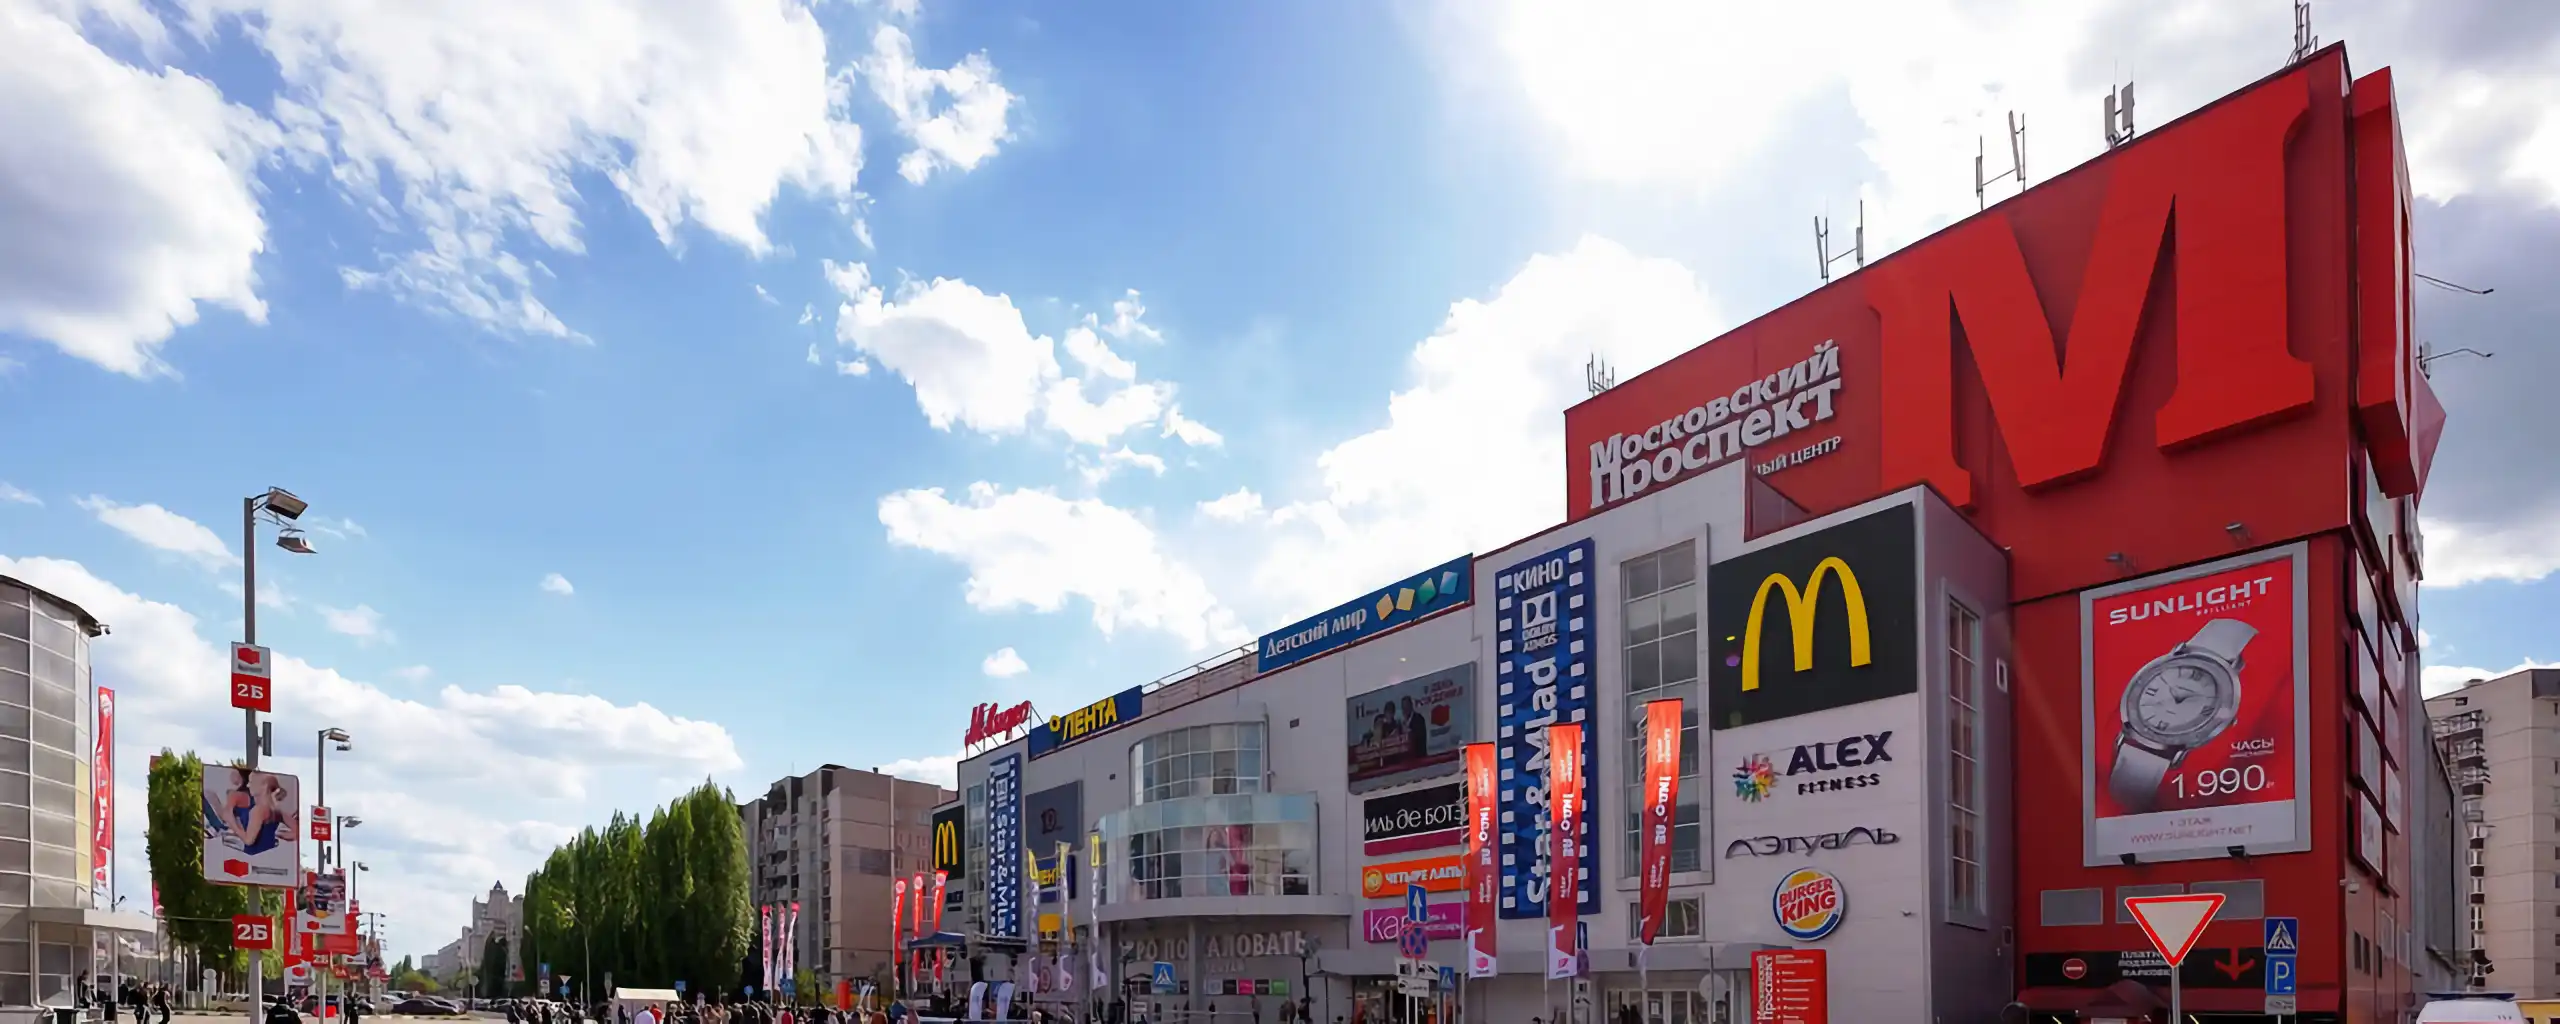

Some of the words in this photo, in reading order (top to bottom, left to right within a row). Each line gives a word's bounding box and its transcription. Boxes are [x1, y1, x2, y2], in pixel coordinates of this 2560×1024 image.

[1590, 339, 1840, 470] Московский
[1590, 378, 1841, 509] Проспект
[1791, 435, 1841, 465] ЦЕНТР
[1513, 558, 1564, 593] КИНО
[2109, 577, 2273, 625] SUNLIGHT
[1265, 619, 1328, 658] Детский
[1332, 608, 1368, 635] мир
[237, 683, 264, 699] 2Б
[1062, 697, 1118, 741] ЛЕНТА
[1786, 731, 1893, 776] ALEX
[2230, 738, 2274, 751] ЧАСЫ
[1798, 773, 1881, 795] FITNESS
[2171, 765, 2265, 799] 1.990
[1779, 878, 1833, 908] BURGER
[1781, 891, 1836, 925] KING
[237, 923, 268, 941] 2Б
